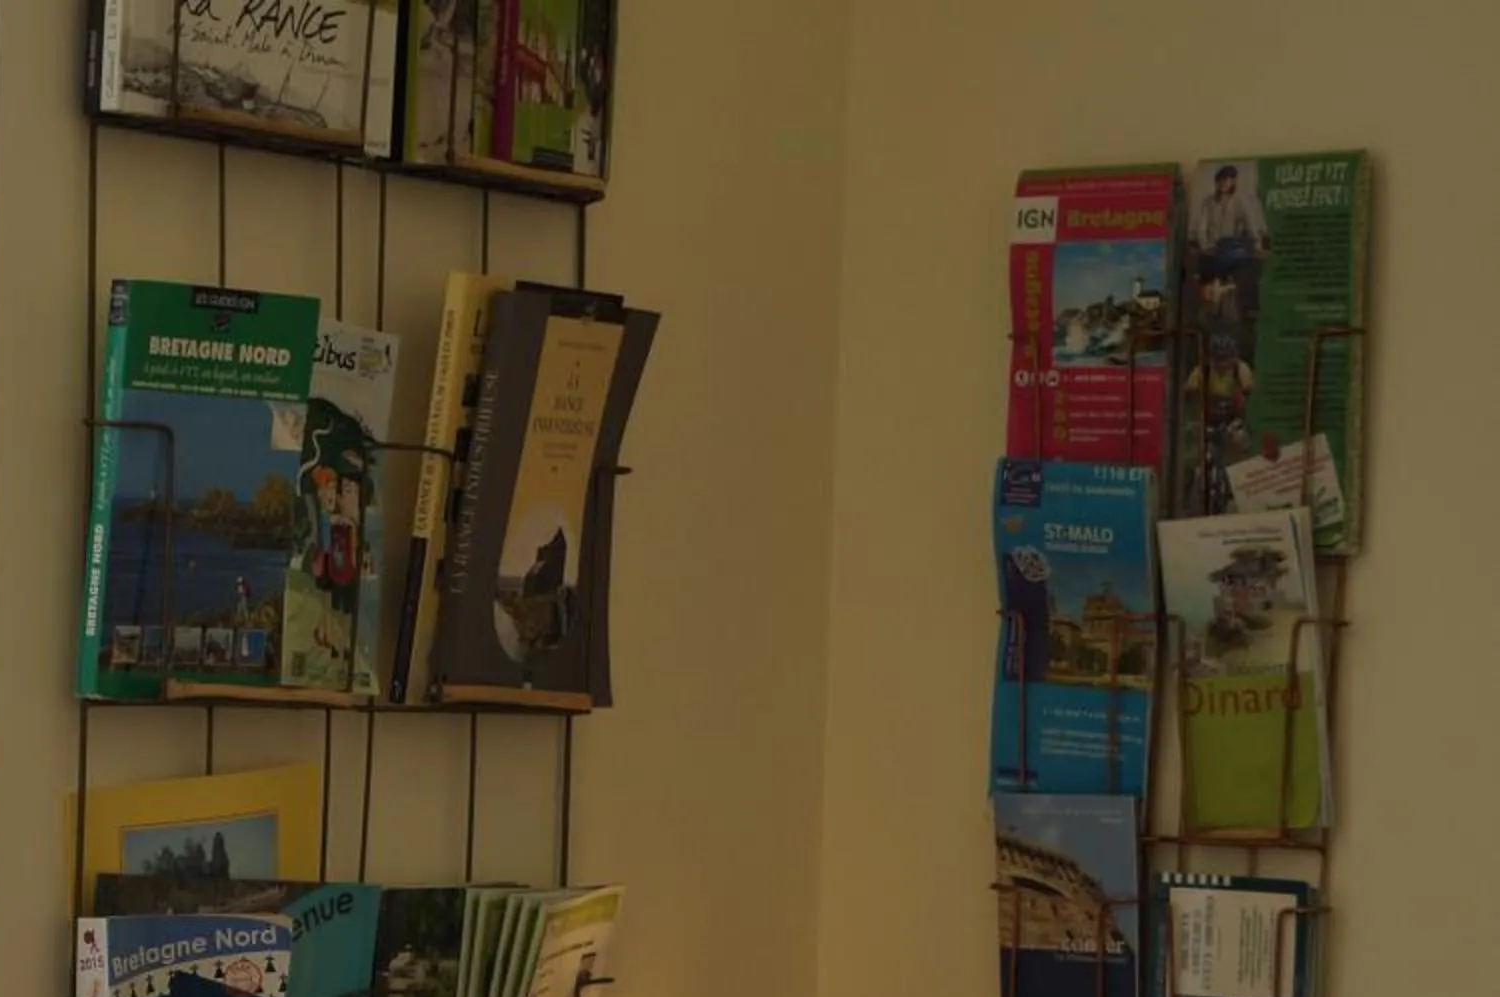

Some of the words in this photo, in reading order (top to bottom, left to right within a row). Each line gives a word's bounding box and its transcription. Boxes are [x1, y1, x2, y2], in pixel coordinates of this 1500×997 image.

[236, 0, 347, 43] RANCE
[1016, 208, 1055, 229] IGN
[149, 335, 234, 361] BRETAGNE
[239, 343, 292, 367] NORD
[1044, 522, 1115, 545] ST-MALO
[112, 936, 207, 978] Bretagne
[215, 924, 277, 951] Nord
